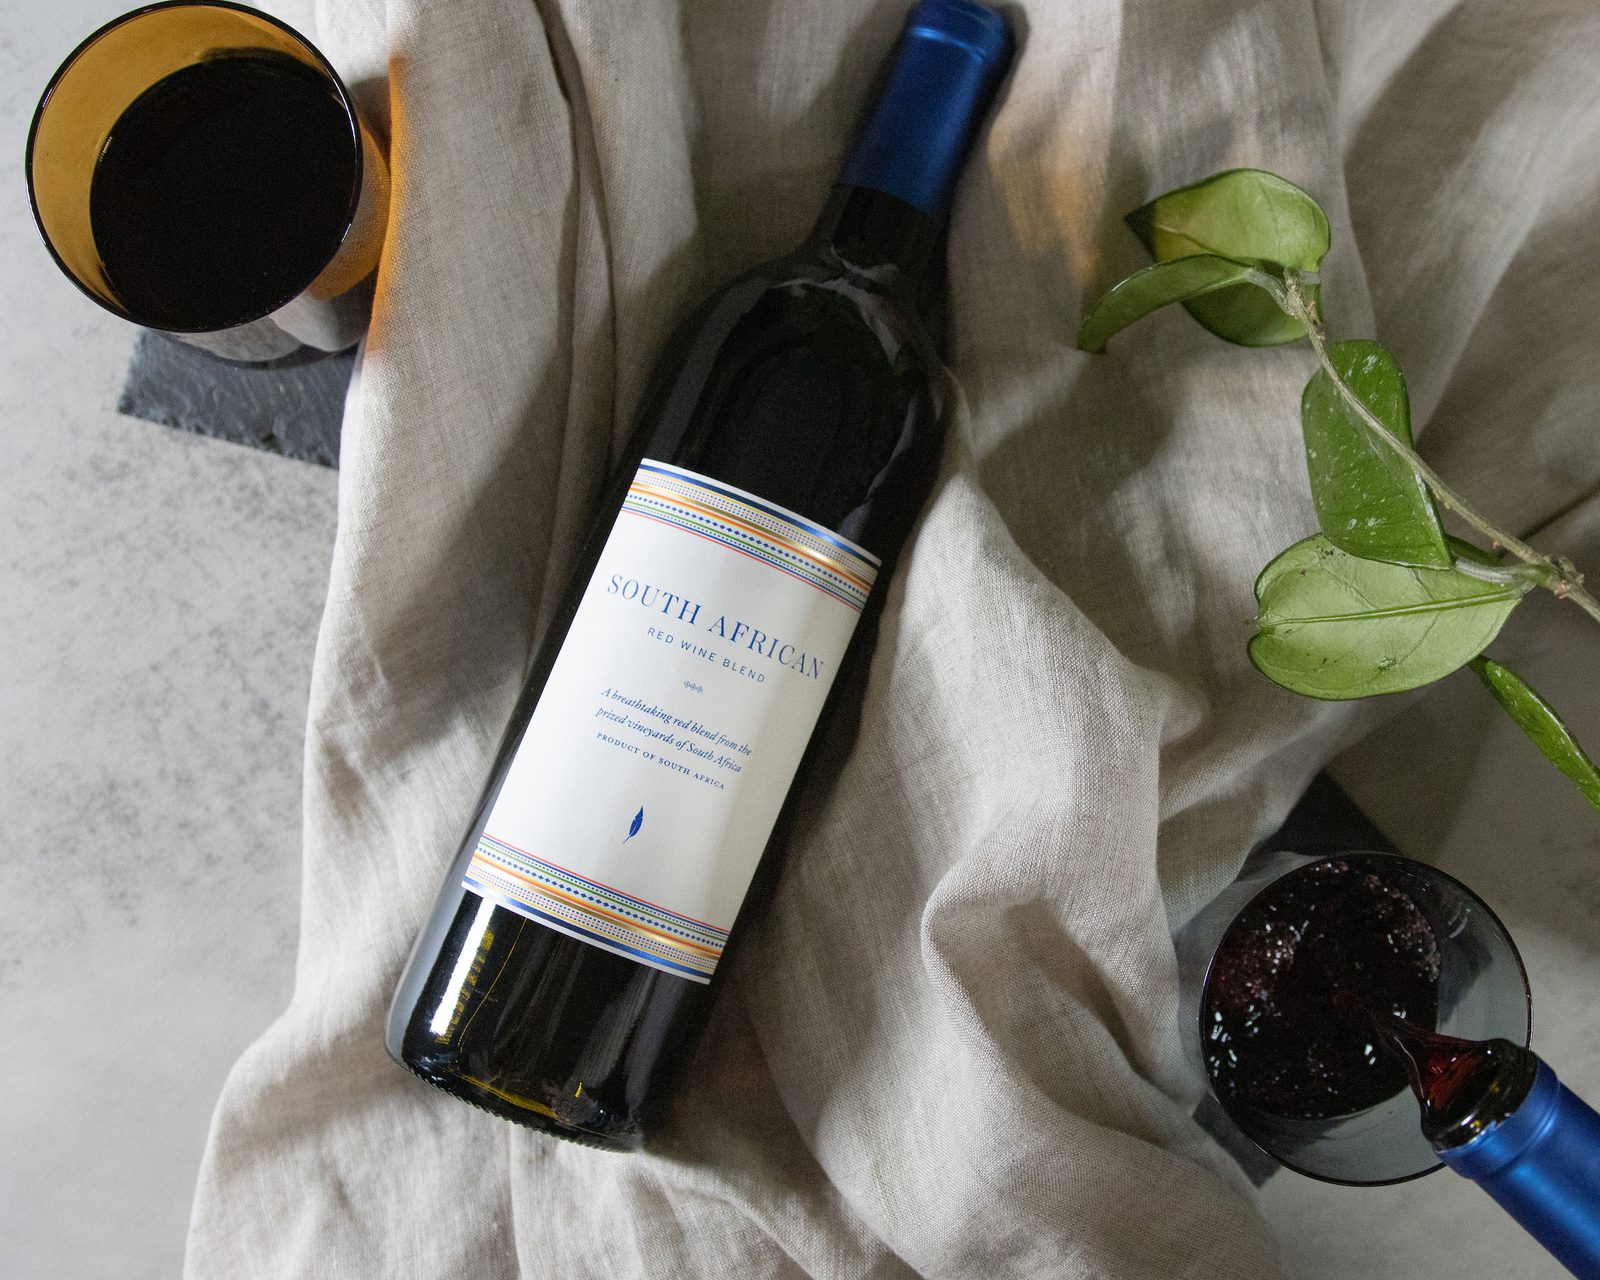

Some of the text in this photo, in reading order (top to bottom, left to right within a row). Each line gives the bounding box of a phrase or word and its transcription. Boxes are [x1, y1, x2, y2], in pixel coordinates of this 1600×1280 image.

[607, 574, 824, 680] SOUTH AFRICAN
[647, 628, 766, 683] RED WINE BLEND
[595, 708, 741, 772] prized vineyards of South Africa
[601, 688, 752, 756] A breathtaking red blend from the
[597, 732, 724, 790] PRODUCT OF SOUTH AFRICA
